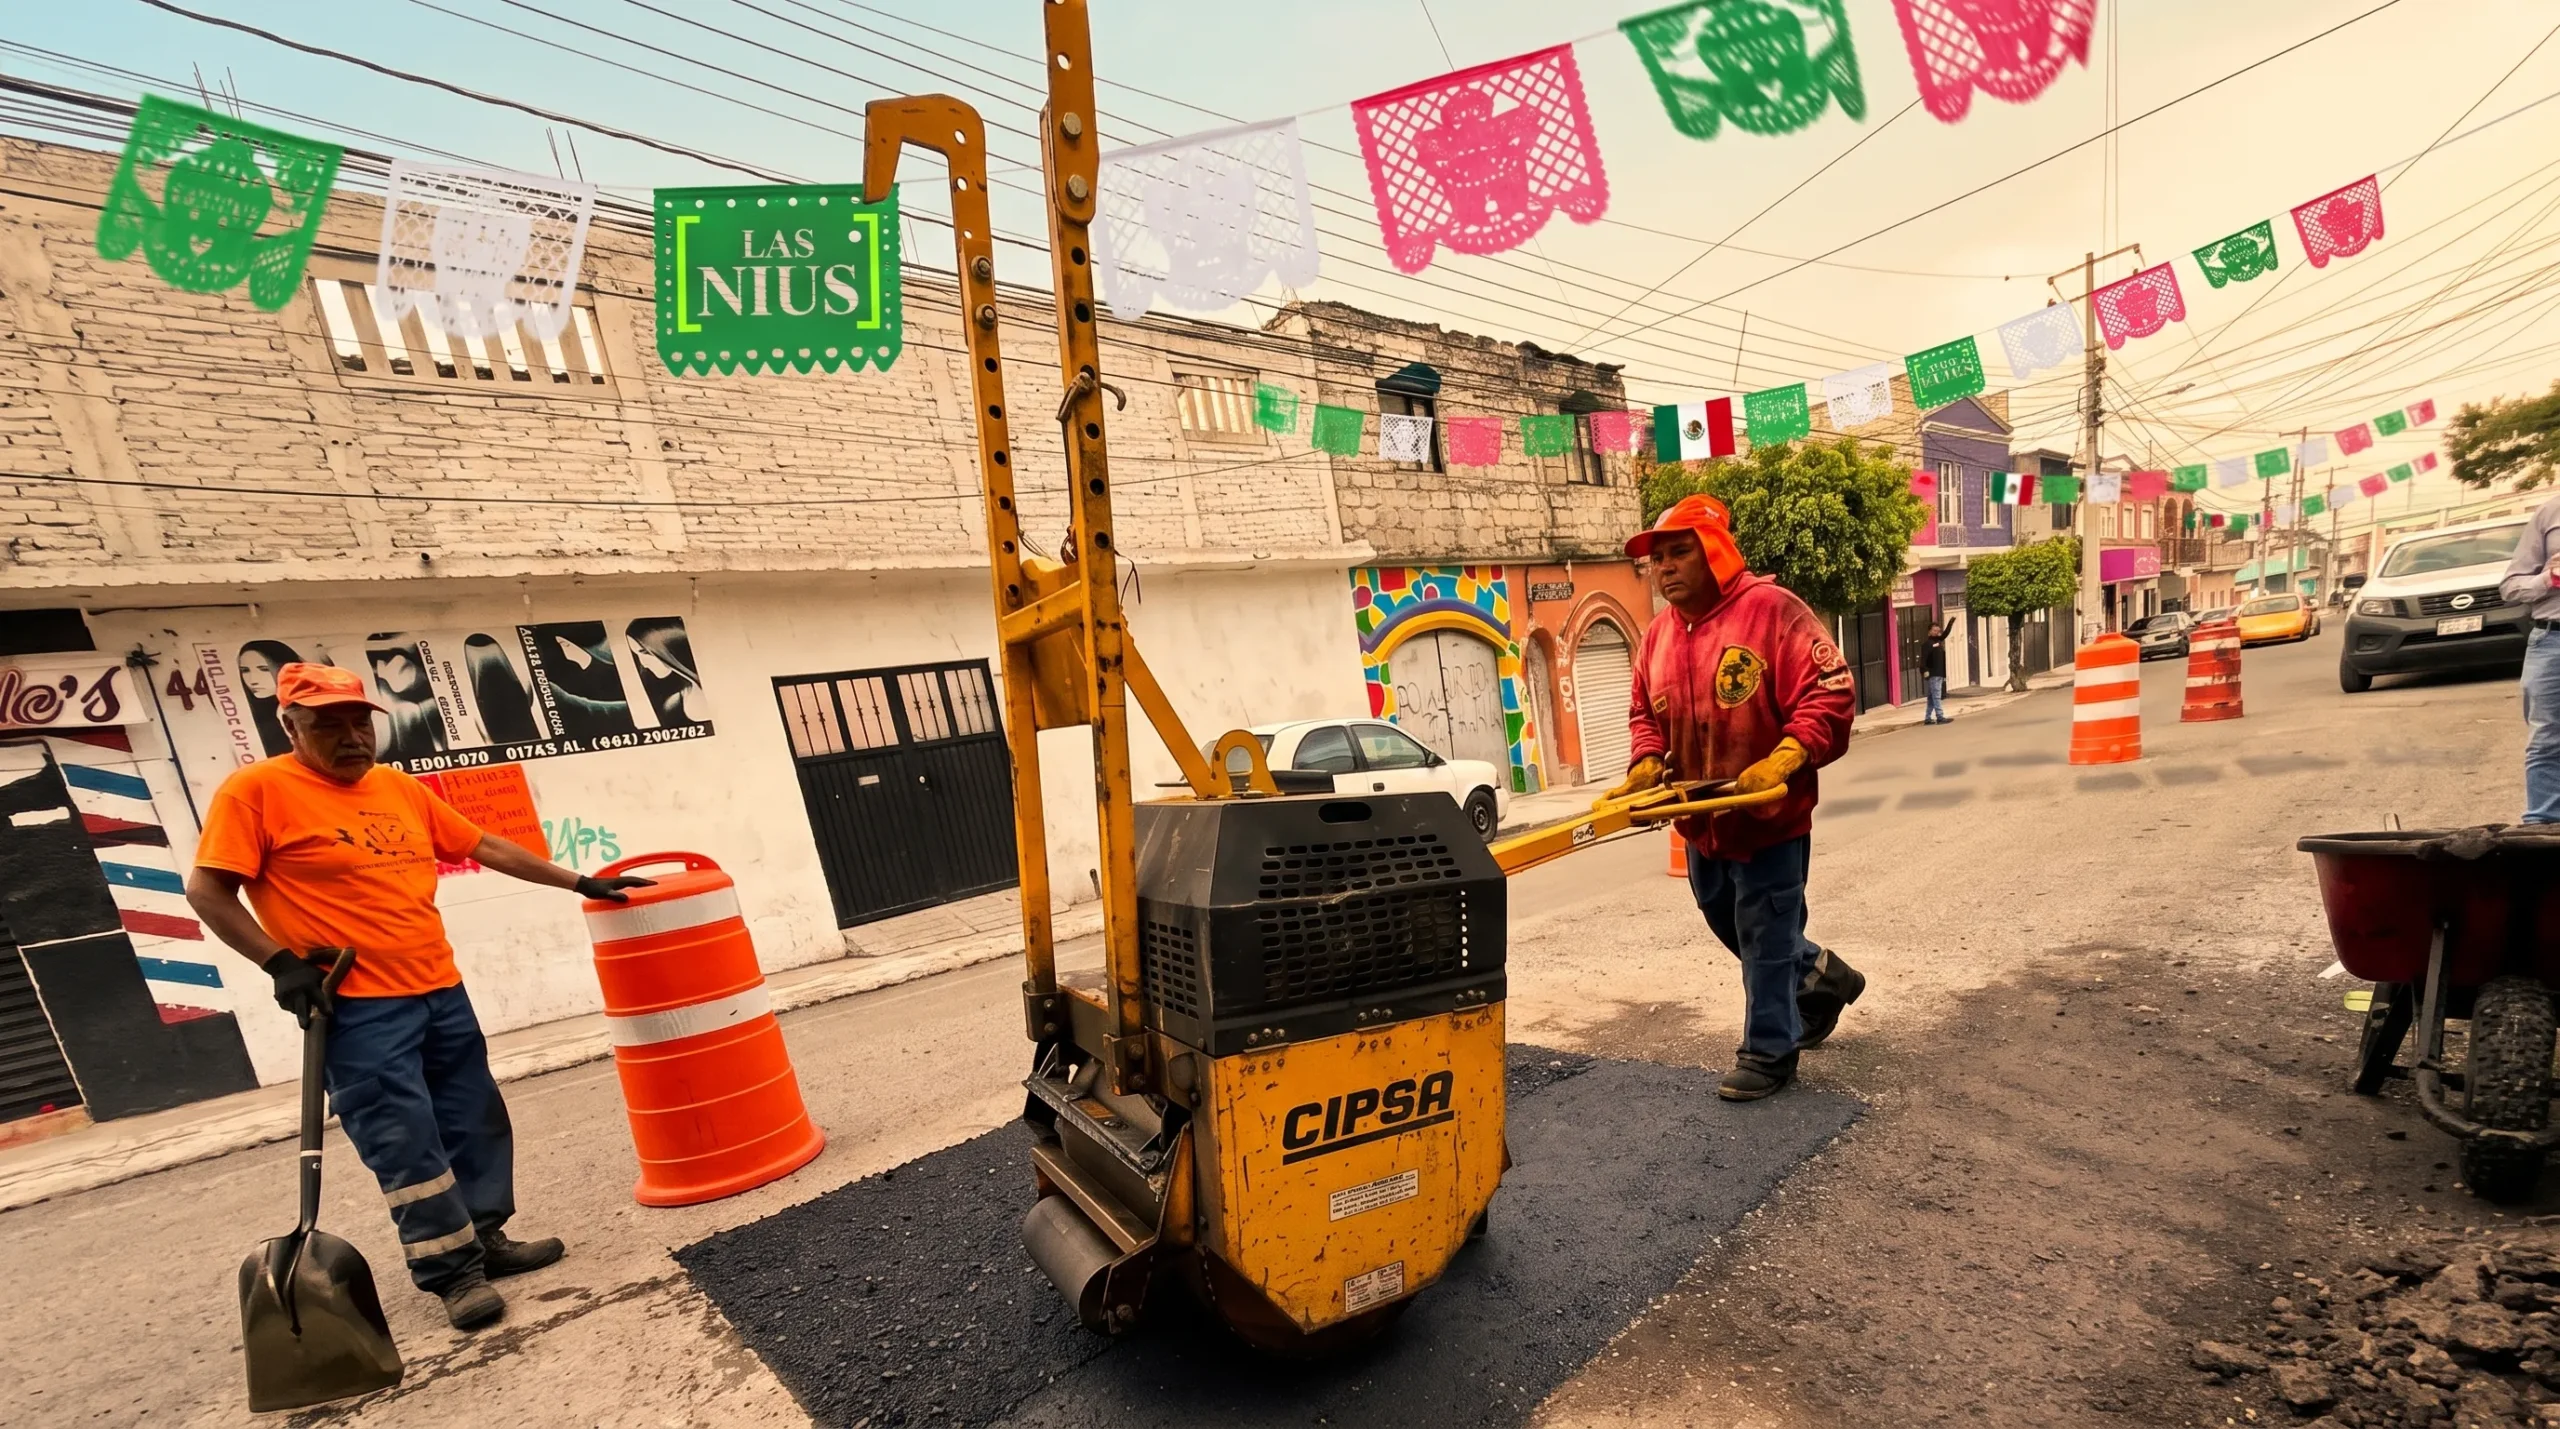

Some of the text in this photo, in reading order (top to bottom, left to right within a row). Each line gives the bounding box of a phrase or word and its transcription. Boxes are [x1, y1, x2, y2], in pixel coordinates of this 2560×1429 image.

[741, 228, 815, 259] LAS
[697, 263, 860, 317] NIUS
[1282, 1070, 1454, 1150] CIPSA
